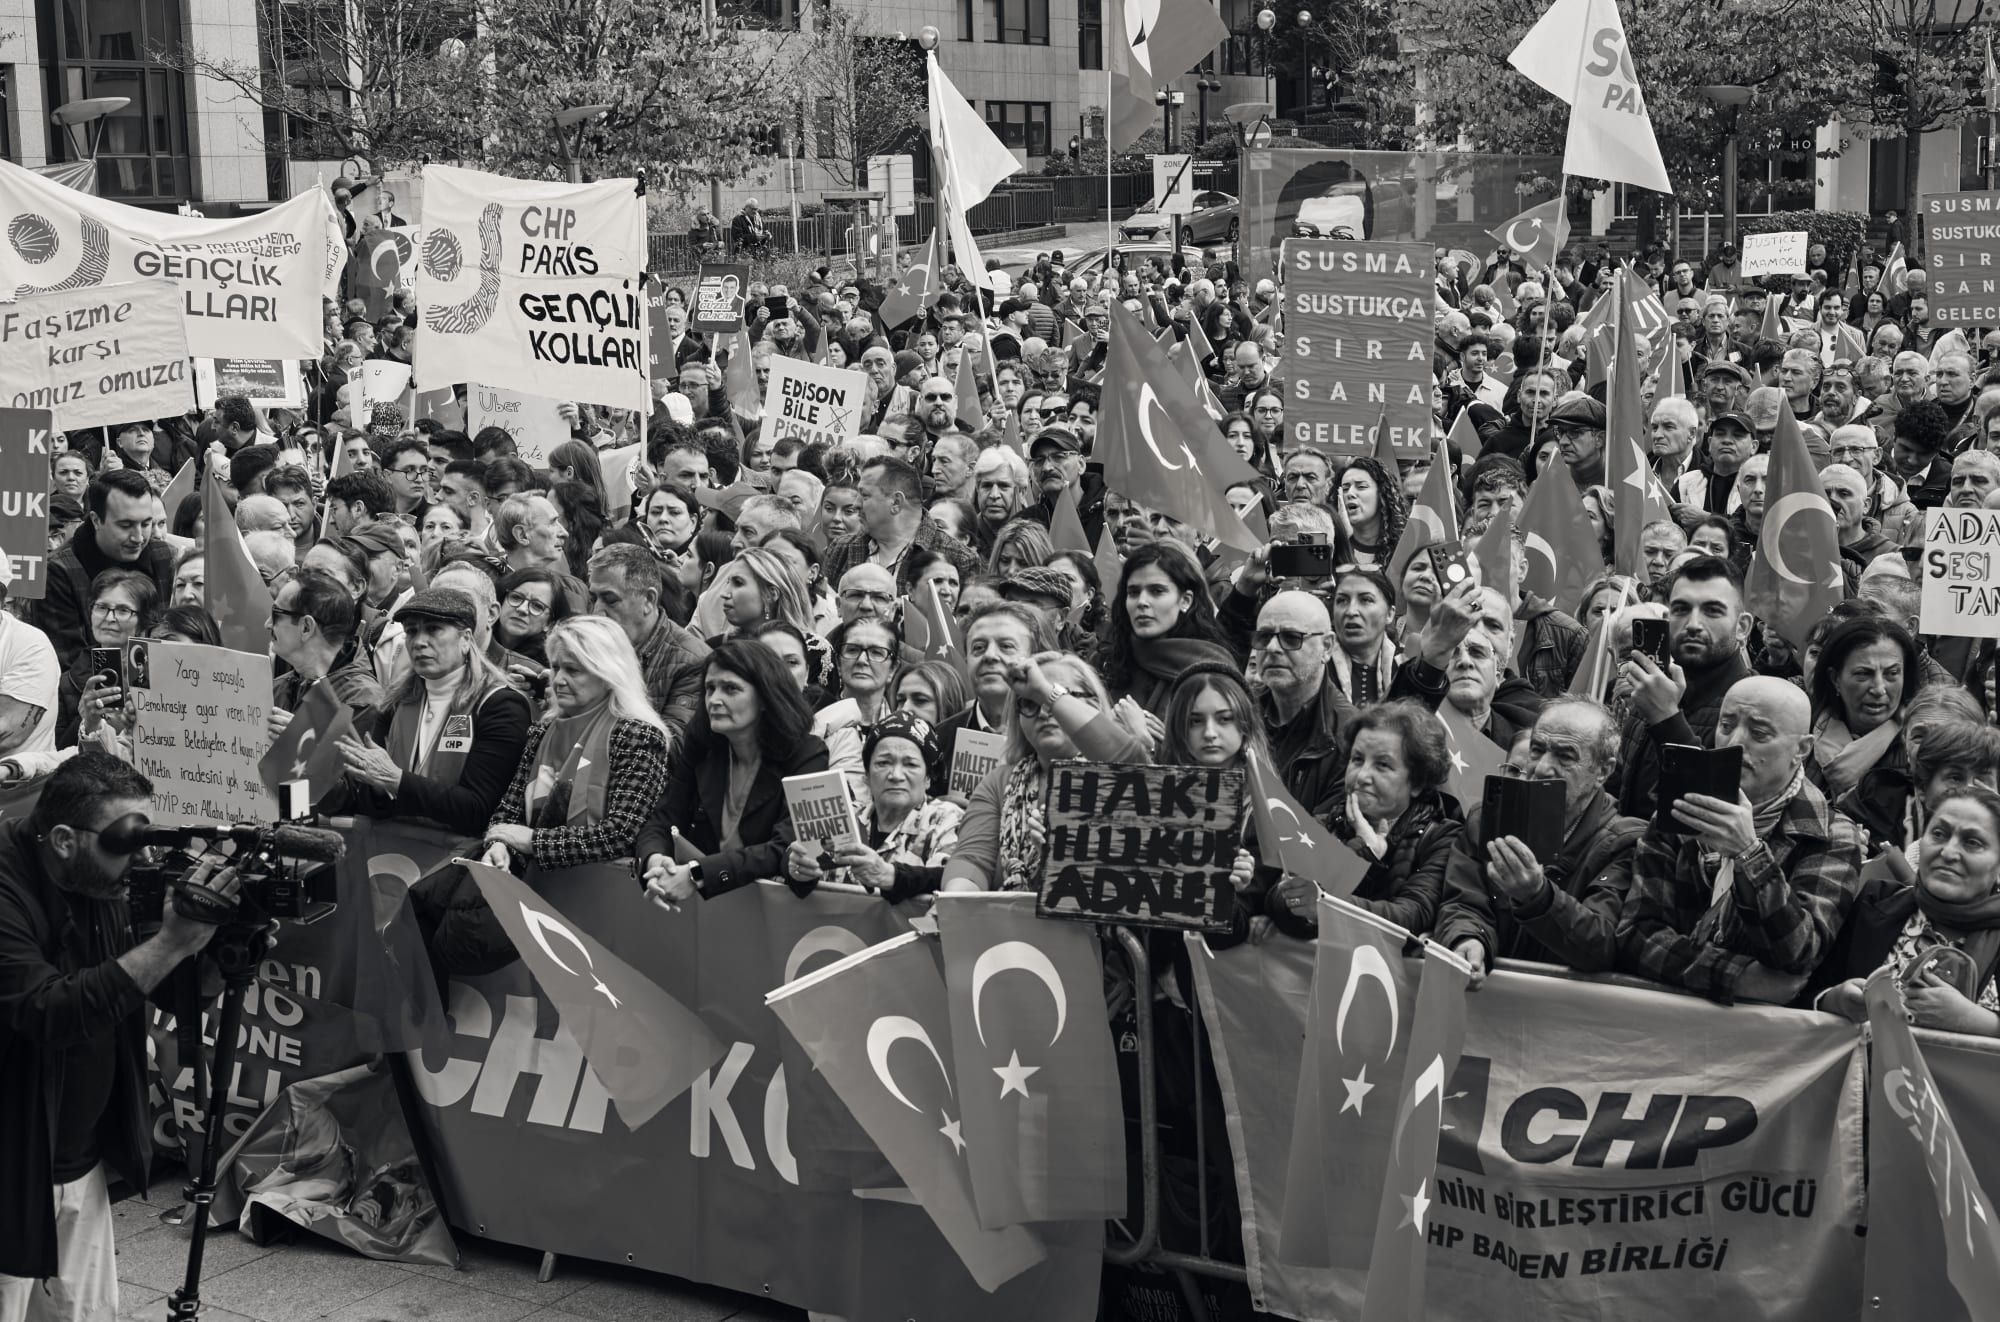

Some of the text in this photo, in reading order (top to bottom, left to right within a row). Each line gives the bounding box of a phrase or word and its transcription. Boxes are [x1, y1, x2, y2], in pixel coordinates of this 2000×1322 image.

[1930, 198, 2000, 213] SUSM
[520, 205, 576, 240] CHP
[1745, 234, 1798, 249] JUSTICE
[134, 250, 282, 289] GENÇLİK
[520, 242, 598, 276] PARİS
[1296, 250, 1425, 279] SUSMA,
[2, 302, 132, 342] Faşizme
[1296, 294, 1426, 323] SUSTUKÇA
[1936, 307, 2000, 320] GELEC
[48, 338, 121, 367] karşı
[1296, 337, 1425, 361] SIRA
[12, 359, 184, 408] omuz omuza
[1295, 379, 1424, 405] SANA
[478, 391, 522, 412] Uber
[196, 705, 219, 723] ayar
[445, 740, 463, 749] CHP
[141, 758, 171, 779] Milletin
[180, 767, 223, 786] iradesini
[182, 801, 198, 816] seni
[791, 795, 846, 822] MİLLETE
[1058, 770, 1220, 822] HAK!
[799, 815, 850, 842] EMANET
[1501, 1086, 1758, 1170] CHP
[1494, 1184, 1705, 1228] BİRLEŞTİRİCİ
[1721, 1176, 1817, 1218] GÜCÜ
[1472, 1233, 1568, 1279] BADEN
[1580, 1236, 1729, 1276] BİRLİĞİ
